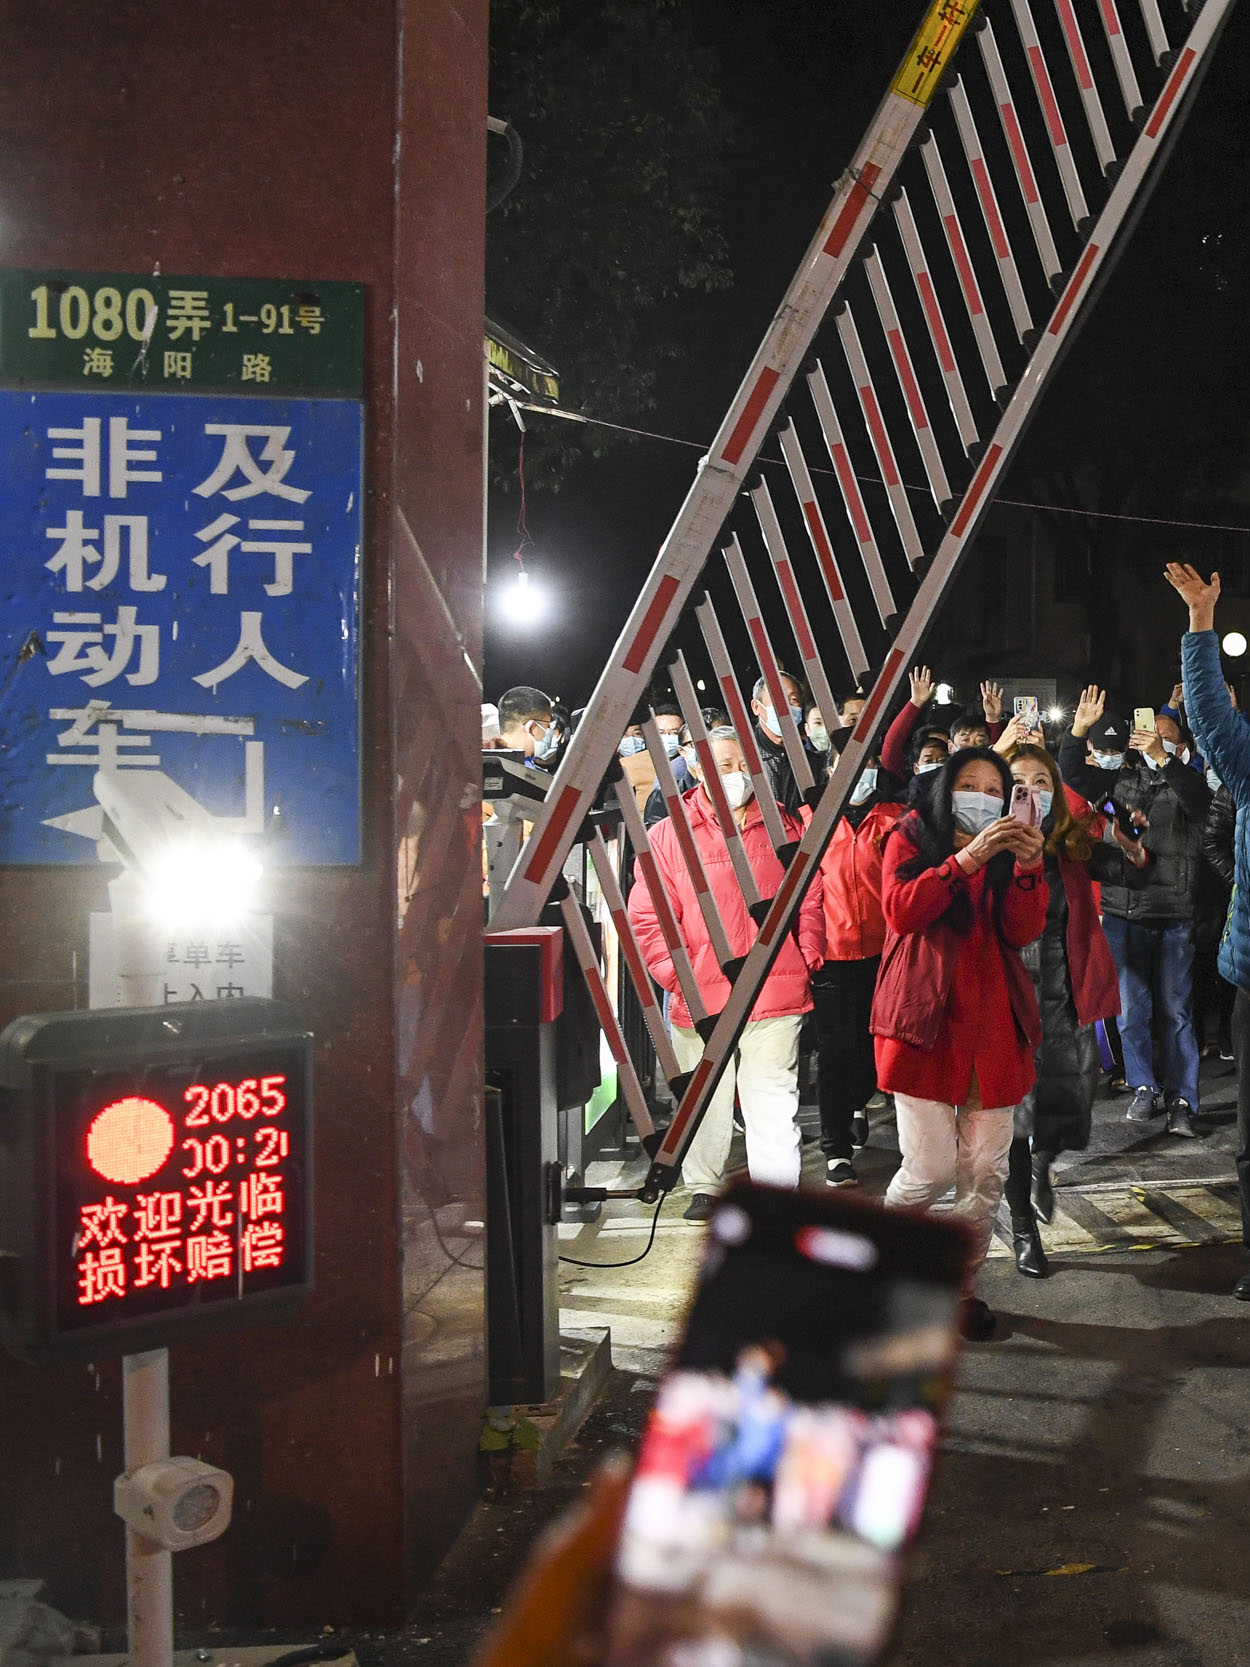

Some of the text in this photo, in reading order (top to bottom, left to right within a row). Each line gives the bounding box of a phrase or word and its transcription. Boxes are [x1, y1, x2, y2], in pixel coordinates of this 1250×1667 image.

[911, 0, 966, 94] 一车一杆
[28, 286, 326, 341] 1080弄 1-91号
[83, 348, 273, 382] 海阳路
[191, 423, 314, 690] 及行人
[184, 1076, 286, 1128] 2065
[78, 1172, 284, 1249] 欢迎光临
[78, 1221, 284, 1304] 损坏赔偿
